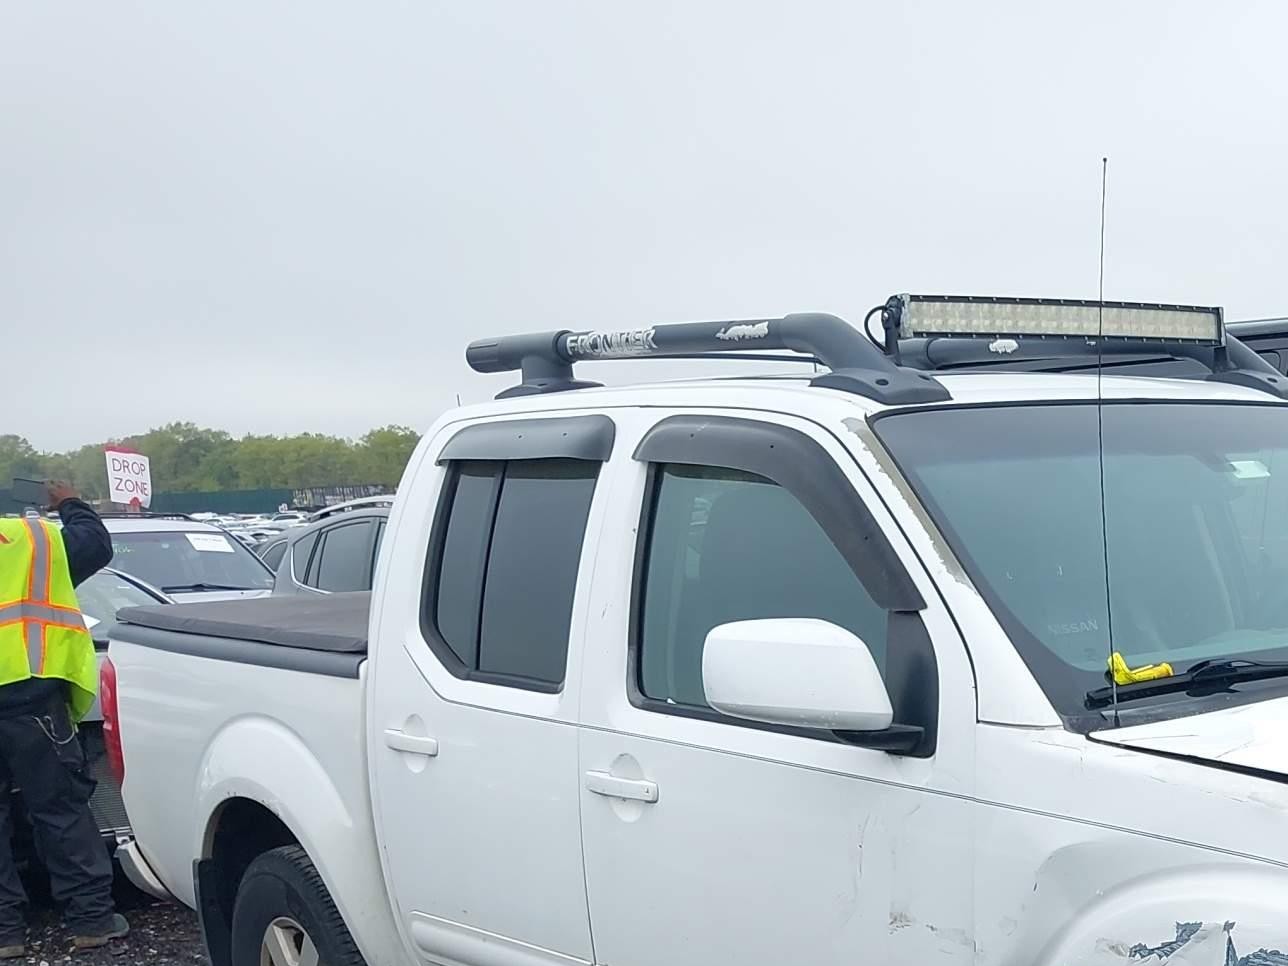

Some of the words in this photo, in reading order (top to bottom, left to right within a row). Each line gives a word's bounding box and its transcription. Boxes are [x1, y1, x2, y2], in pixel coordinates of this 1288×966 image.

[112, 458, 145, 476] DROP
[114, 477, 148, 496] ZONE
[1047, 619, 1099, 634] NISSAN
